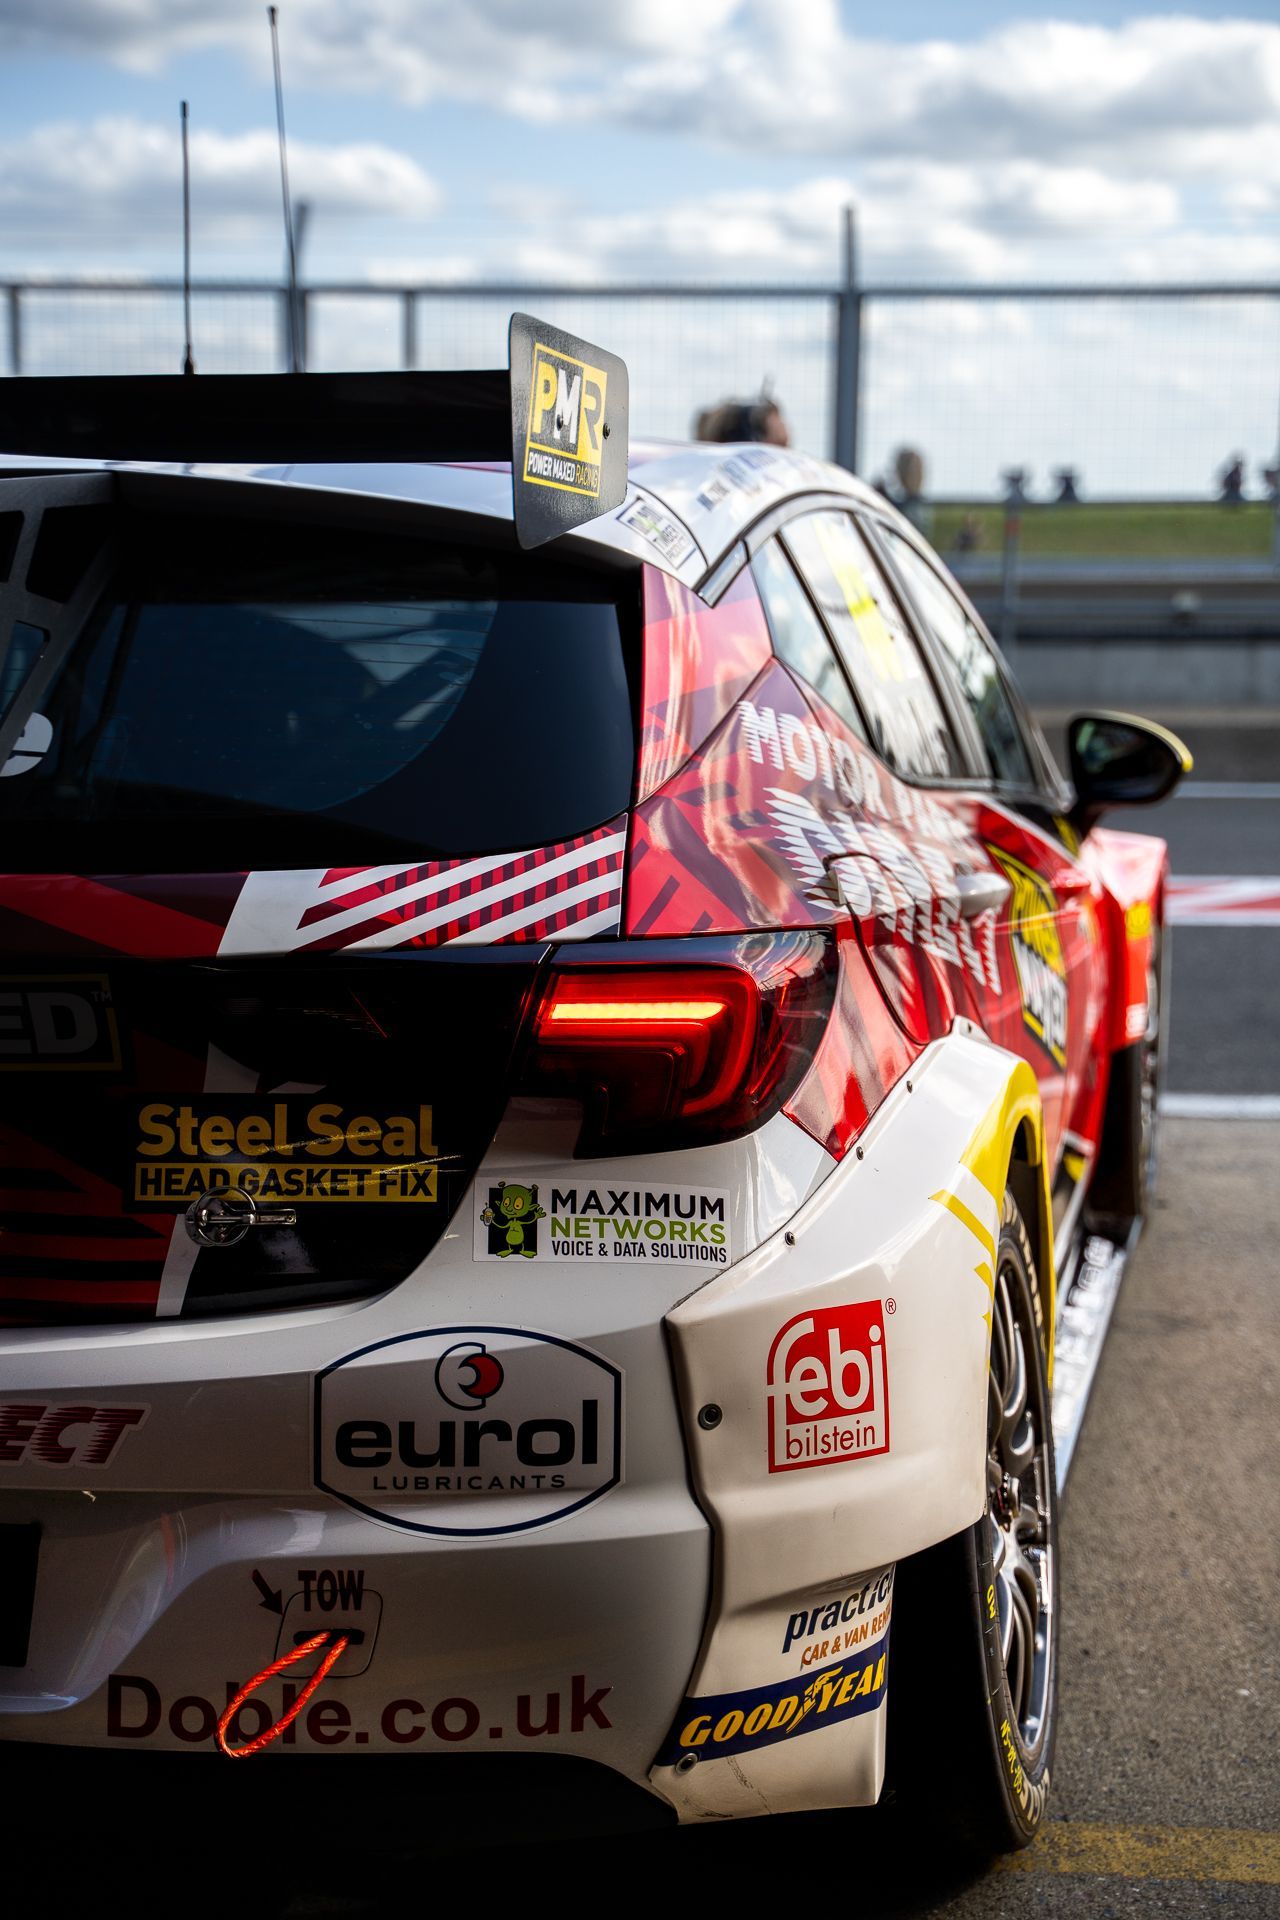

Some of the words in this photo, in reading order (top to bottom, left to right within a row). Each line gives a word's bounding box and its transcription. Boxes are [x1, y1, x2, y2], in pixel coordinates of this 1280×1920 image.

[532, 360, 602, 450] PMR
[527, 452, 553, 477] POWER
[552, 456, 576, 482] MAXED
[575, 463, 599, 489] RACING
[737, 700, 892, 821] MOTOR
[136, 1103, 293, 1156] Steel
[305, 1103, 438, 1156] Seal
[139, 1167, 231, 1196] HEAD
[237, 1168, 372, 1197] GASKET
[378, 1168, 433, 1197] FIX
[551, 1188, 725, 1221] MAXIMUM
[550, 1217, 726, 1244] NETWORKS
[551, 1240, 594, 1256] VOICE
[598, 1242, 609, 1257] &
[613, 1242, 647, 1258] DATA
[650, 1243, 727, 1263] SOLUTIONS
[767, 1317, 885, 1417] febi
[335, 1399, 599, 1469] eurol
[785, 1419, 876, 1460] bilstein
[372, 1474, 567, 1490] LUBRICANTS
[297, 1569, 366, 1612] TOW
[781, 1571, 893, 1655] practic
[801, 1640, 830, 1666] CAR
[830, 1635, 842, 1655] &
[843, 1621, 869, 1649] VAN
[106, 1673, 613, 1746] Doble.co.uk
[679, 1651, 887, 1747] GOODYEAR
